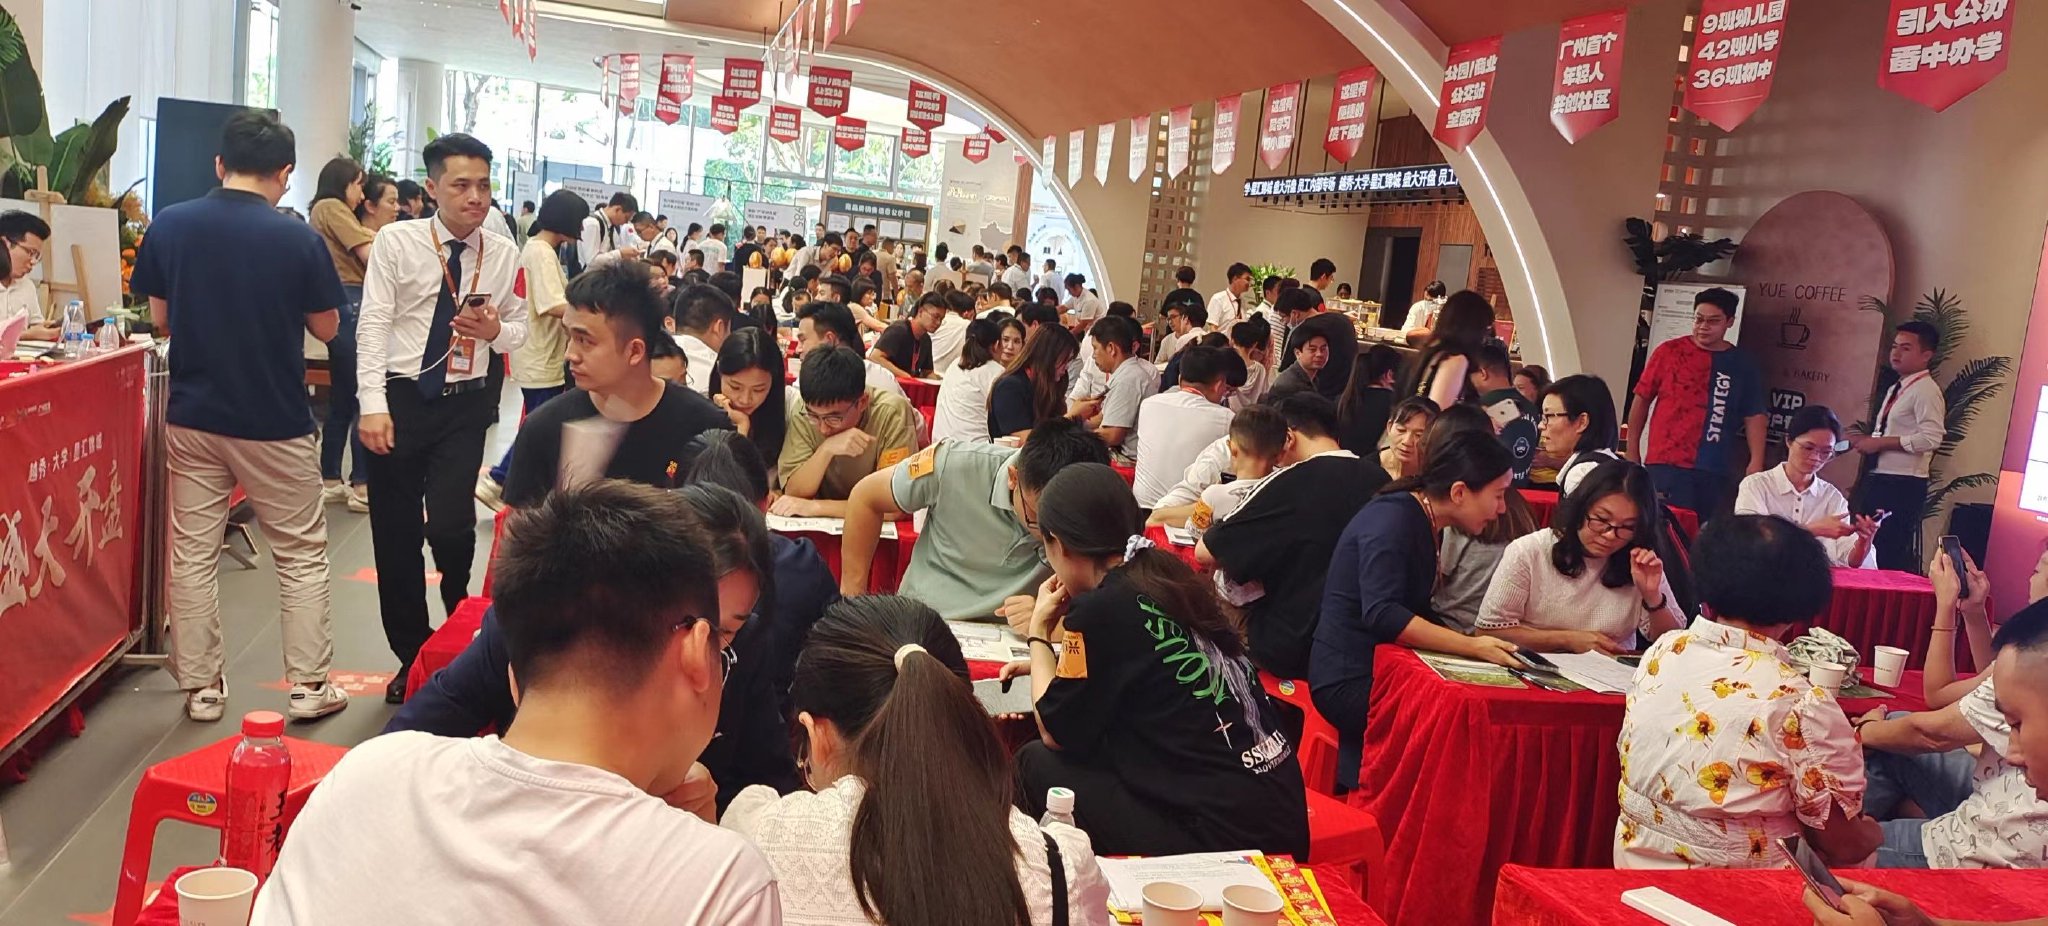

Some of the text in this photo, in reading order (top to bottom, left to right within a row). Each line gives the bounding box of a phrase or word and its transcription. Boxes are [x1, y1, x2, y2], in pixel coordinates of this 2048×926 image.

[1702, 0, 1786, 34] 9班幼儿园
[1896, 0, 2008, 36] 引入公办
[1560, 32, 1618, 60] 广州首个
[1698, 29, 1779, 60] 42班小学
[1889, 30, 2003, 73] 番中办学
[1444, 54, 1498, 82] 公园/商业
[1562, 61, 1604, 86] 年轻人
[1692, 59, 1772, 88] 36班初中
[1450, 81, 1486, 104] 公交站
[1553, 88, 1612, 114] 共创社区
[1446, 106, 1482, 128] 全配齐
[1274, 179, 1297, 194] 盛大开盘
[1298, 176, 1336, 193] 员工内部专场
[1402, 168, 1436, 188] 盛大开盘
[1438, 168, 1458, 186] 员工
[1758, 282, 1848, 302] YUE COFFEE
[1794, 368, 1830, 382] BAKERY
[1706, 372, 1730, 442] STRATEGY
[1772, 392, 1802, 410] VIP
